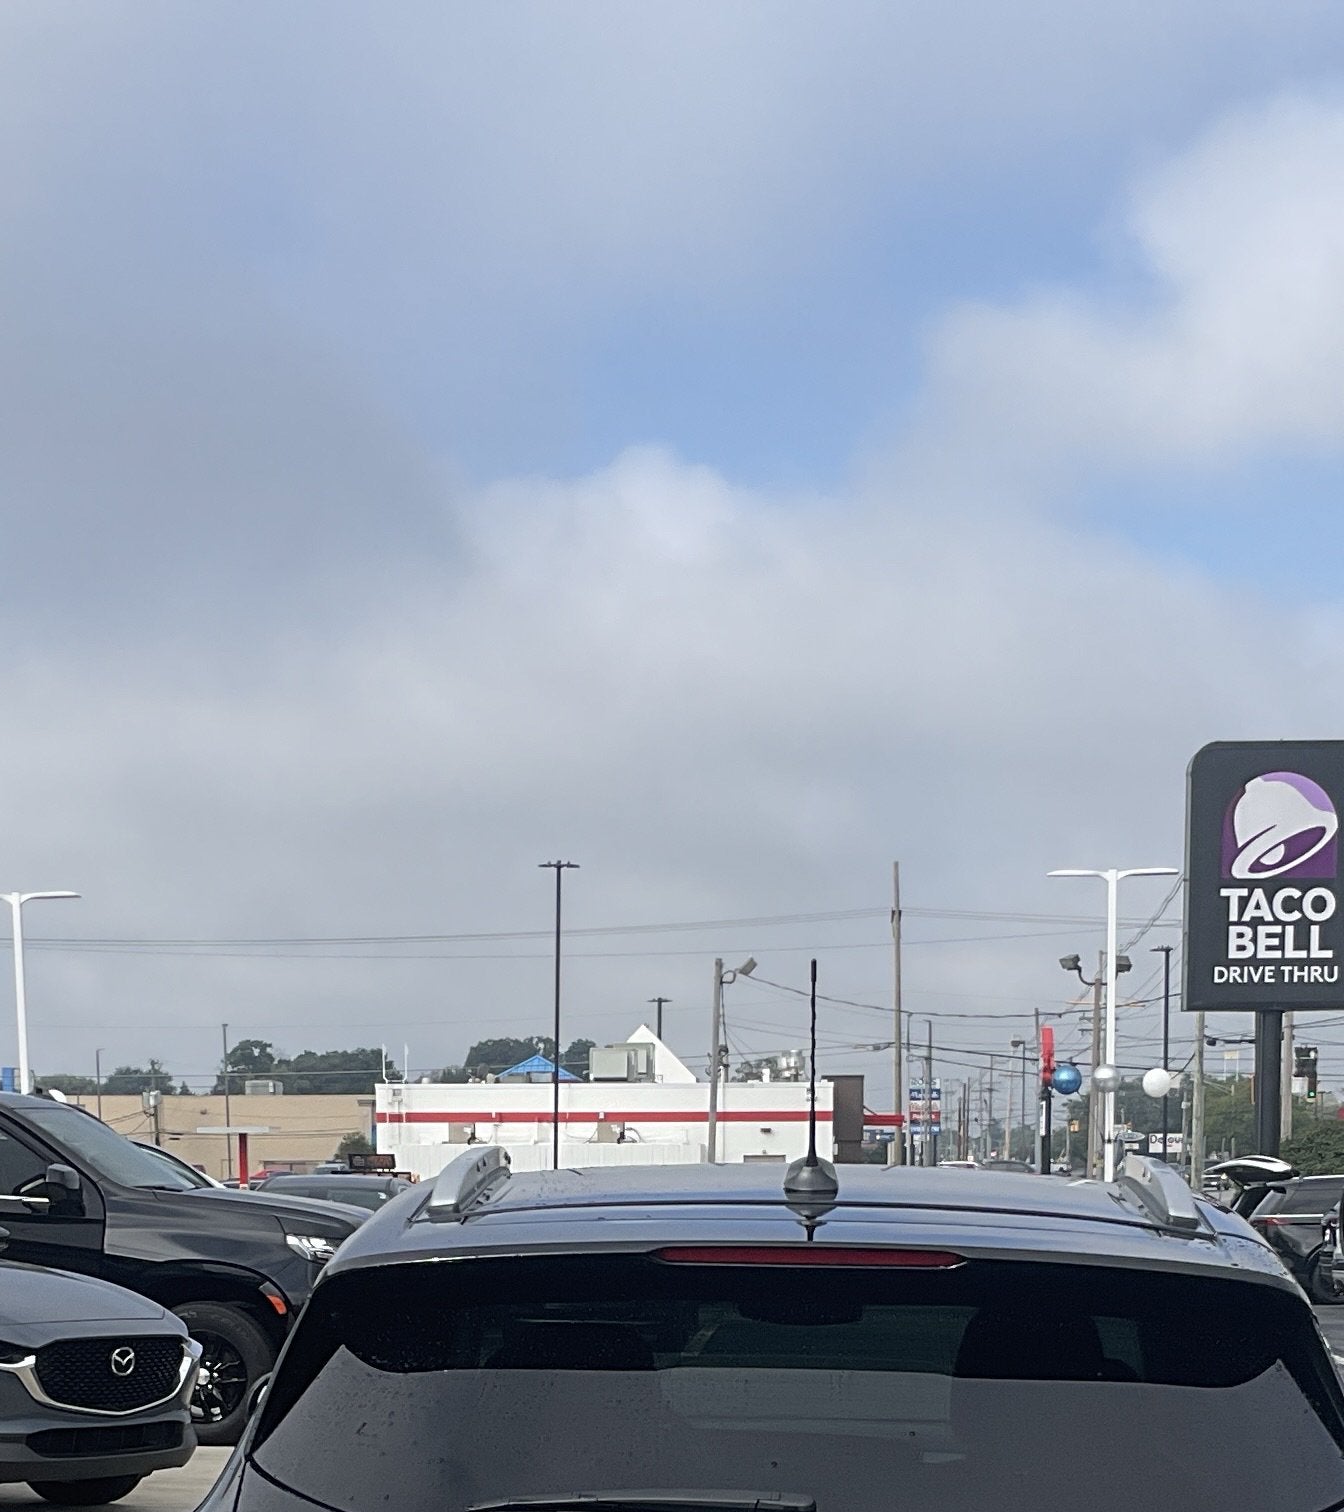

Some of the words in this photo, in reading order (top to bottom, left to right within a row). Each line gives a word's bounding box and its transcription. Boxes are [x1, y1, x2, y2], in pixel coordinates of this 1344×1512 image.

[1219, 887, 1336, 922] TACO
[1228, 924, 1334, 959] BELL
[1213, 965, 1276, 983] DRIVE
[1280, 965, 1339, 983] THRU
